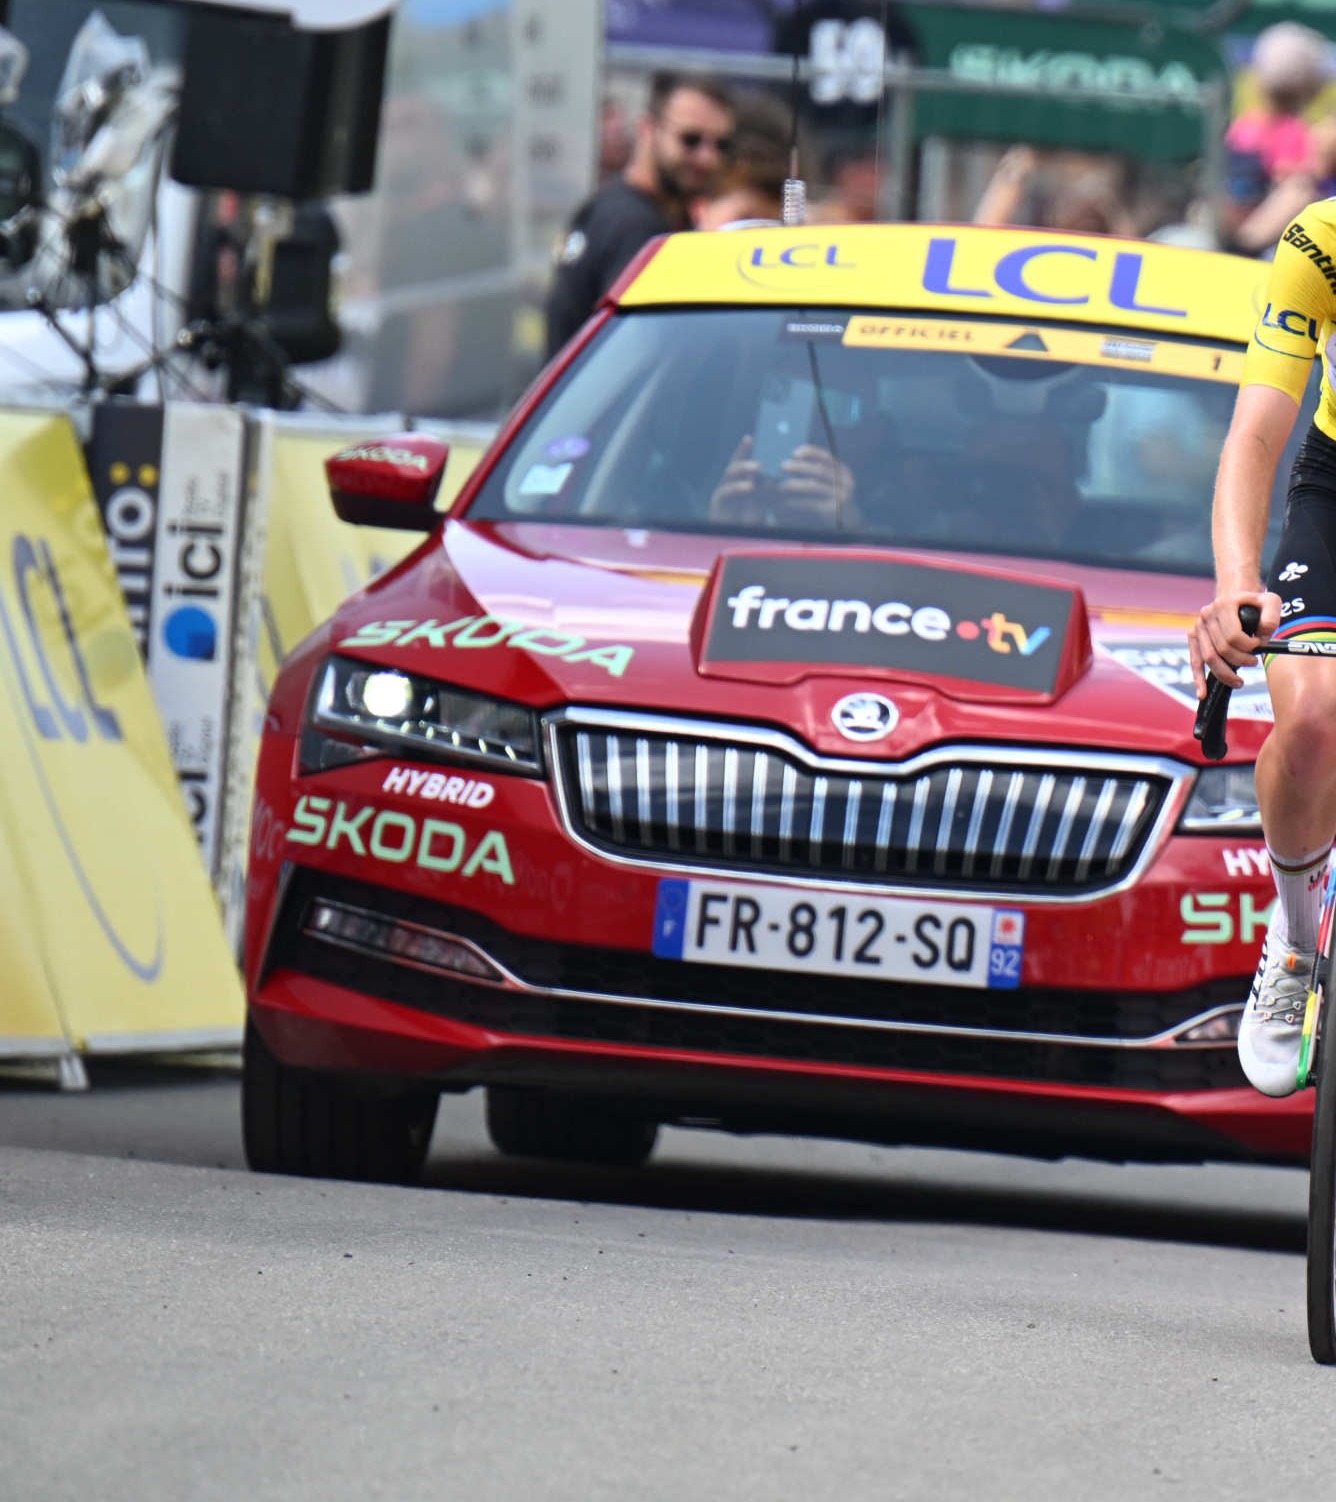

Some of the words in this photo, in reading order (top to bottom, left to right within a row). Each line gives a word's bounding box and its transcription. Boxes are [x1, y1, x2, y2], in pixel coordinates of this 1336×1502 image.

[750, 243, 856, 268] LCL
[921, 238, 1188, 318] LCL
[860, 324, 976, 342] OFFICIEL
[1262, 302, 1320, 343] LCL
[163, 521, 224, 598] ici
[338, 614, 638, 678] SKODA
[382, 766, 496, 809] HYBRID
[285, 795, 516, 886] SKODA
[695, 892, 977, 973] FR-812-SQ
[990, 948, 1020, 977] 92
